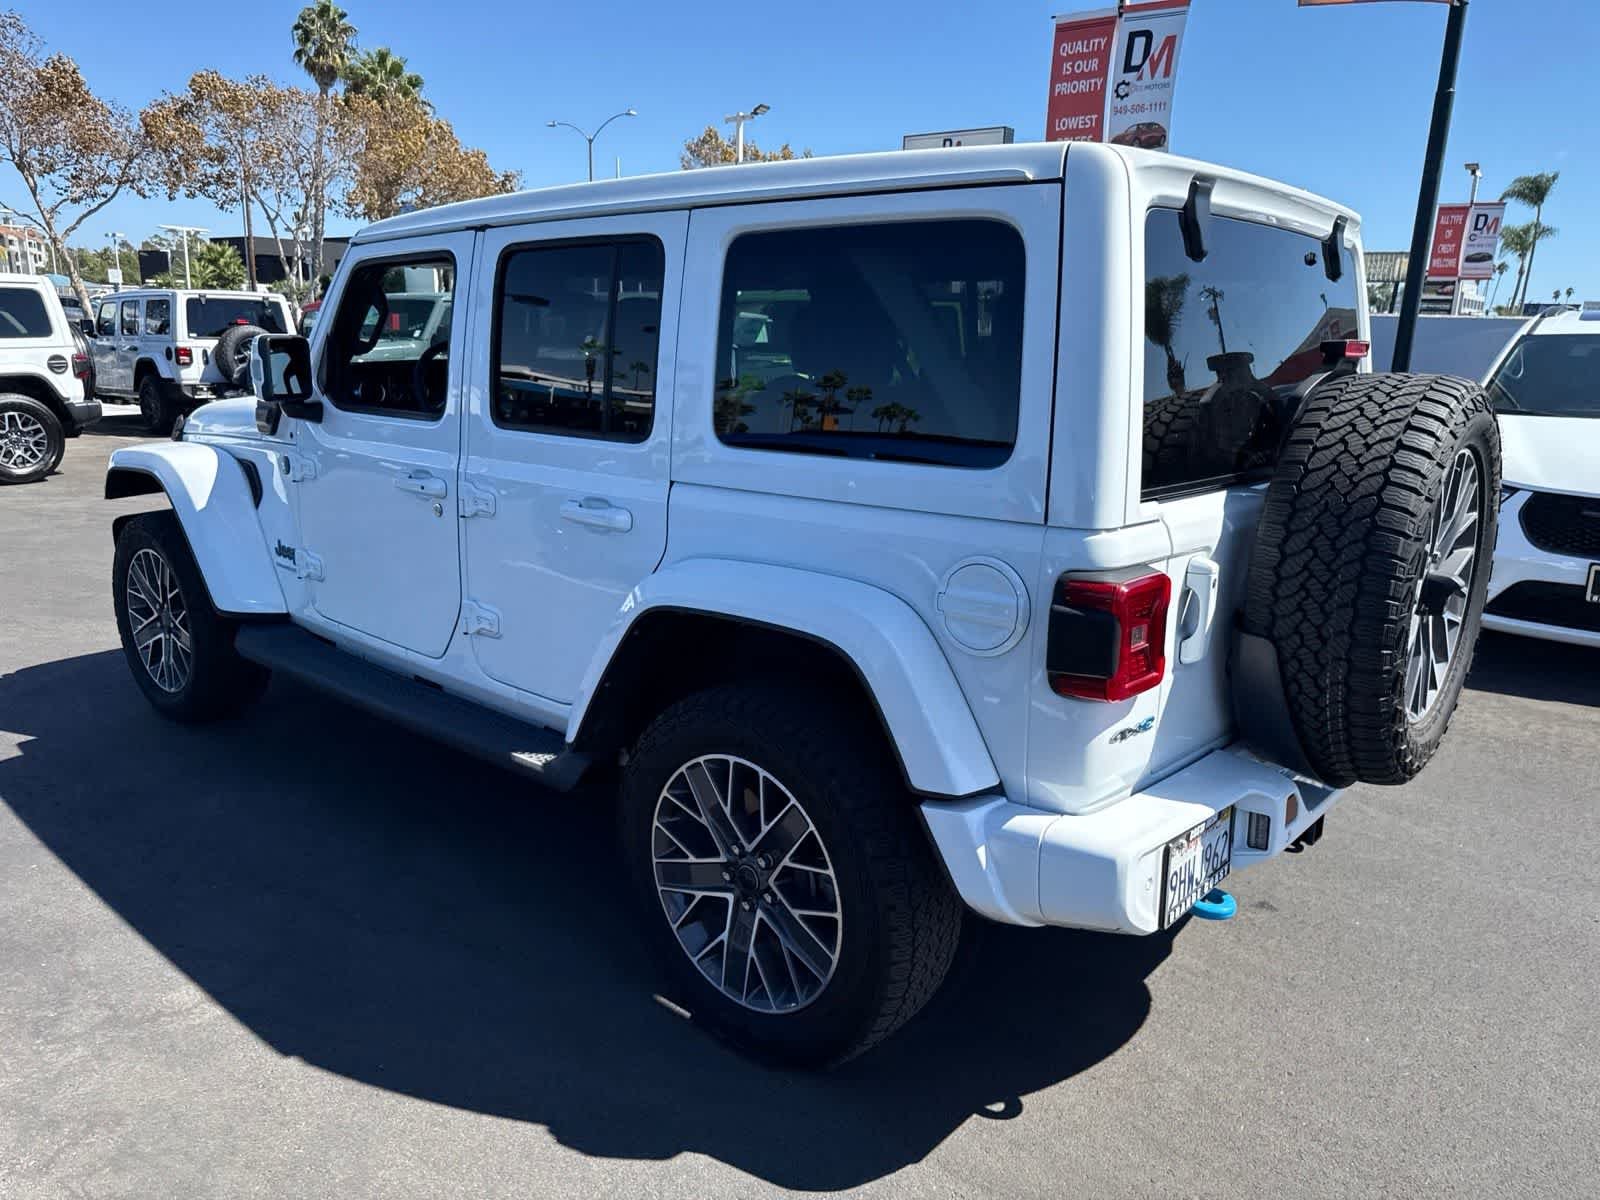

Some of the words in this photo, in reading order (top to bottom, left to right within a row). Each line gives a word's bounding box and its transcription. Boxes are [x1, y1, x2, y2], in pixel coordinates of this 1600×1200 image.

[1060, 37, 1107, 56] QUALITY
[1123, 29, 1176, 80] DM
[1062, 61, 1073, 75] IS
[1074, 58, 1099, 74] OUR
[1055, 79, 1103, 96] PRIORITY
[1055, 115, 1098, 131] LOWEST
